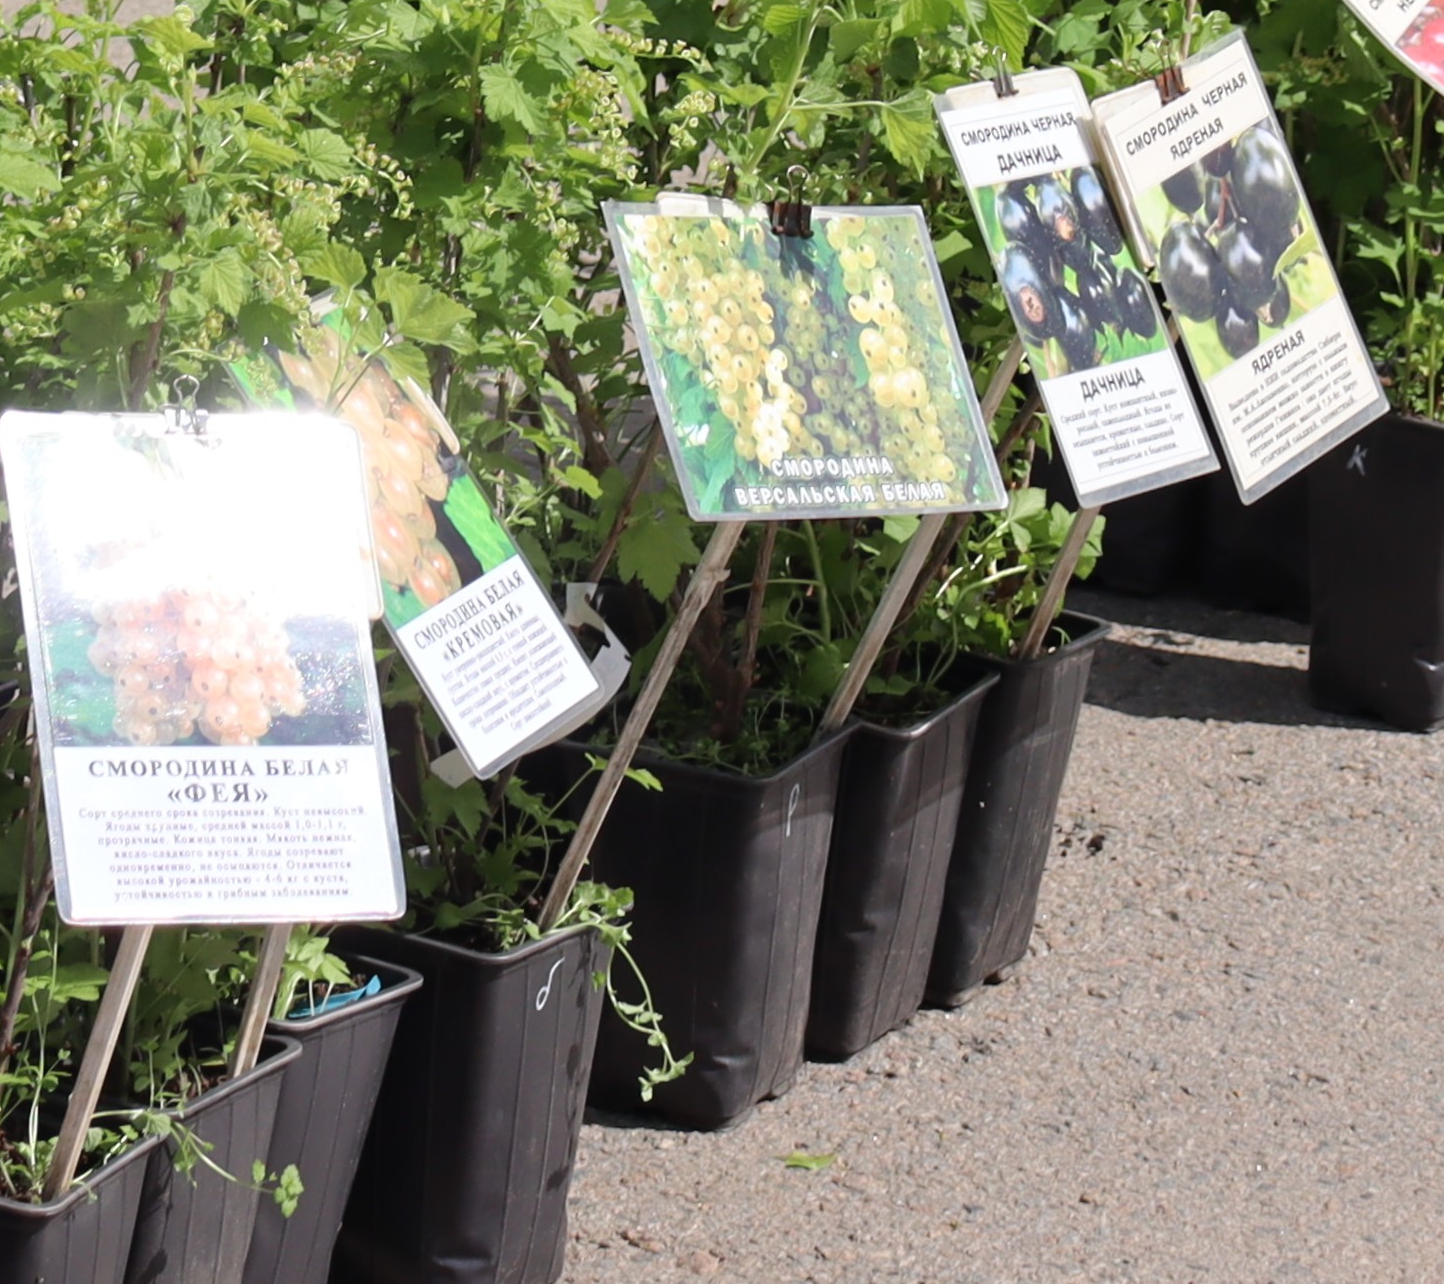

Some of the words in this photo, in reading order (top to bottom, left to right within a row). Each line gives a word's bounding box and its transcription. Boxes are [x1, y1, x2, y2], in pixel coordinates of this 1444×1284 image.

[1126, 102, 1199, 156] СМОРОДИНА
[1202, 71, 1248, 108] ЧЕРНАЯ
[961, 124, 1030, 147] СМОРОДИНА
[1031, 112, 1077, 133] ЧЕРНАЯ
[1169, 117, 1224, 161] ЯДРЕНАЯ
[996, 144, 1063, 174] ДАЧНИЦА
[1251, 330, 1305, 376] ЯДРЕНАЯ
[1080, 367, 1146, 403] ДАЧНИЦА
[770, 456, 894, 478] СМОРОДИНА
[734, 484, 876, 507] ВЕРСАЛЬСКАЯ
[881, 482, 946, 502] БЕЛАЯ
[414, 596, 490, 650] СМОРОДИНА
[484, 569, 525, 607] БЕЛАЯ
[442, 602, 524, 663] «КРЕМОВАЯ»
[88, 758, 256, 779] СМОРОДИНА
[265, 757, 349, 777] БЕЛАЯ
[167, 782, 269, 804] «ФЕЯ»
[79, 808, 107, 820] Сорт
[166, 809, 198, 820] срока
[274, 806, 299, 818] Куст
[106, 821, 141, 832] Ягоды
[247, 847, 282, 857] Ягоды
